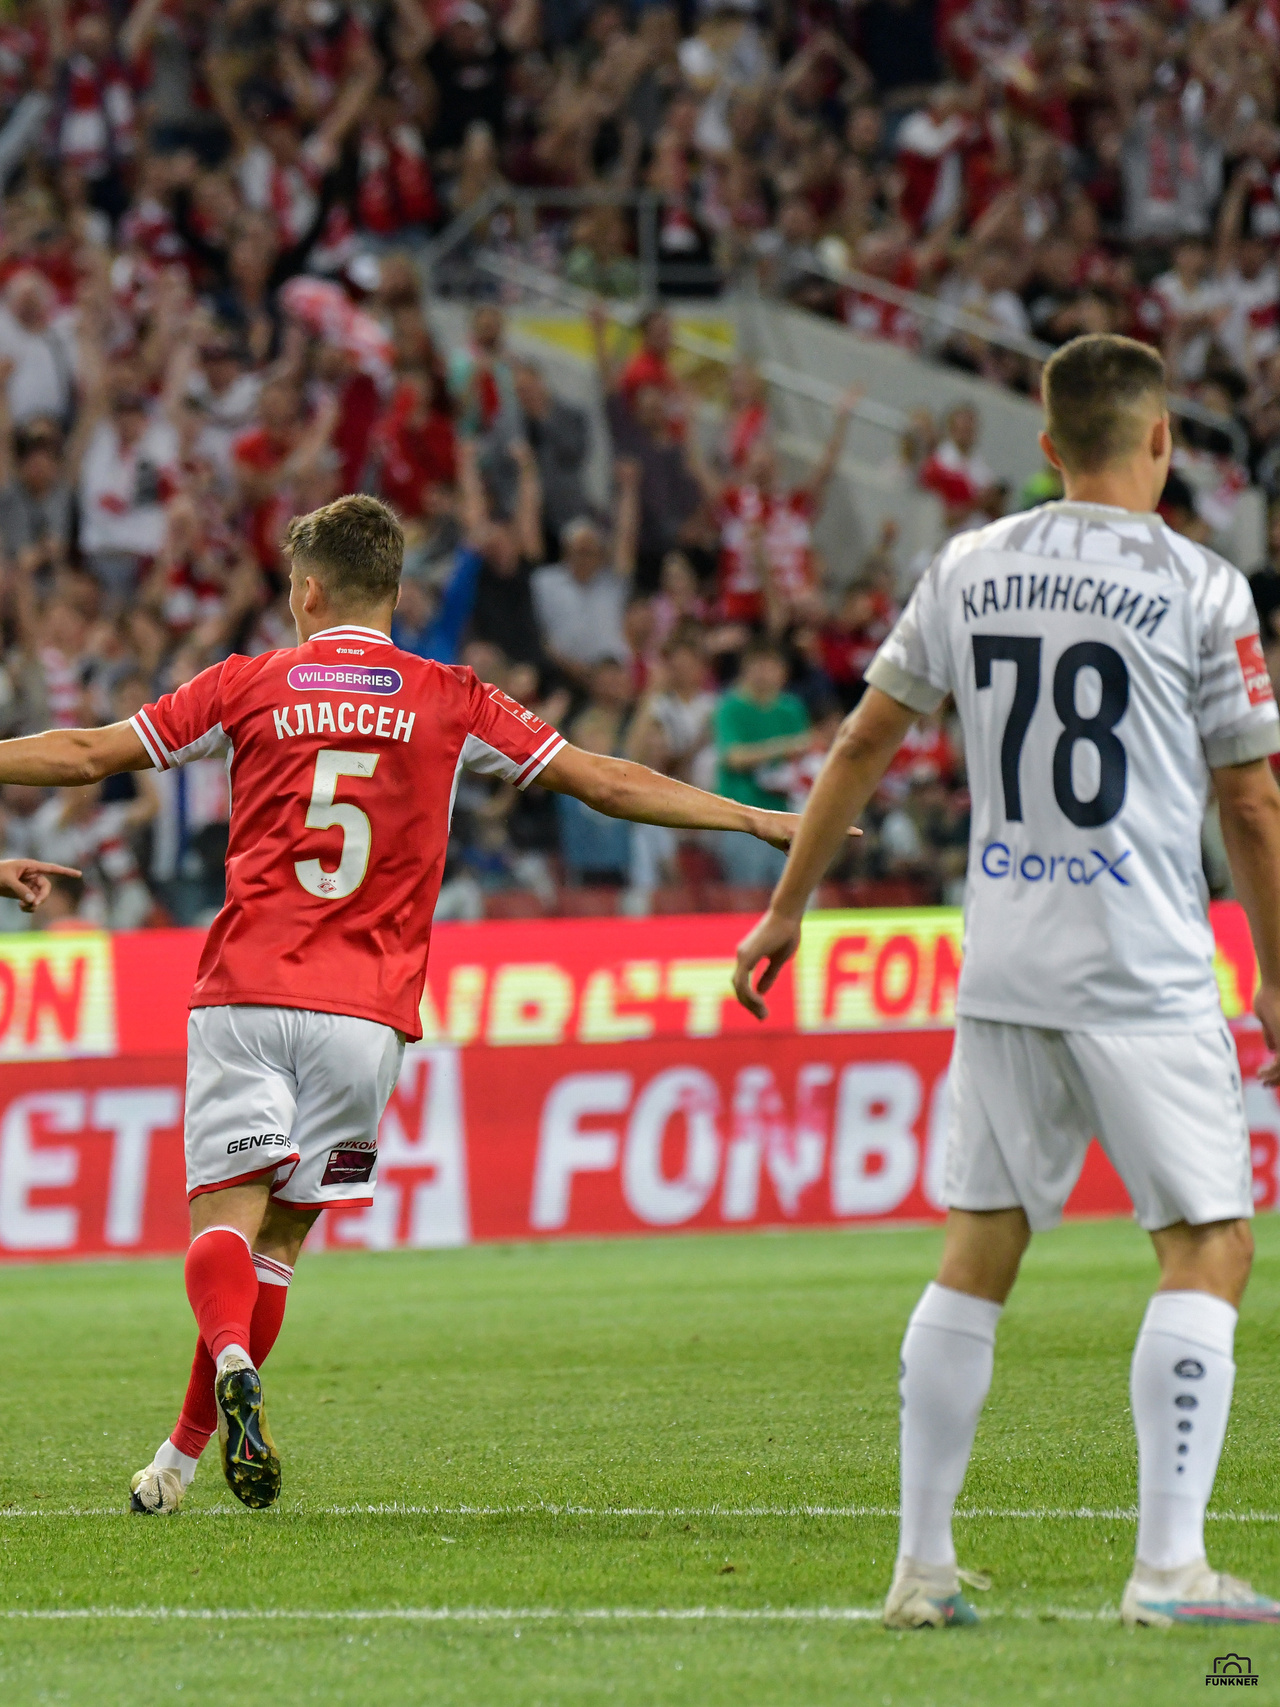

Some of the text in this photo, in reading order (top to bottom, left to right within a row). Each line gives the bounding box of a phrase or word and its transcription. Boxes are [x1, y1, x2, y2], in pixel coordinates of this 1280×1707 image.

[962, 574, 1171, 638] КАЛИНСКИЙ
[298, 671, 393, 687] WILDBERRIES
[272, 702, 416, 743] КЛАССЕН
[972, 634, 1130, 829] 78
[294, 749, 381, 900] 5
[982, 842, 1131, 886] GloraX
